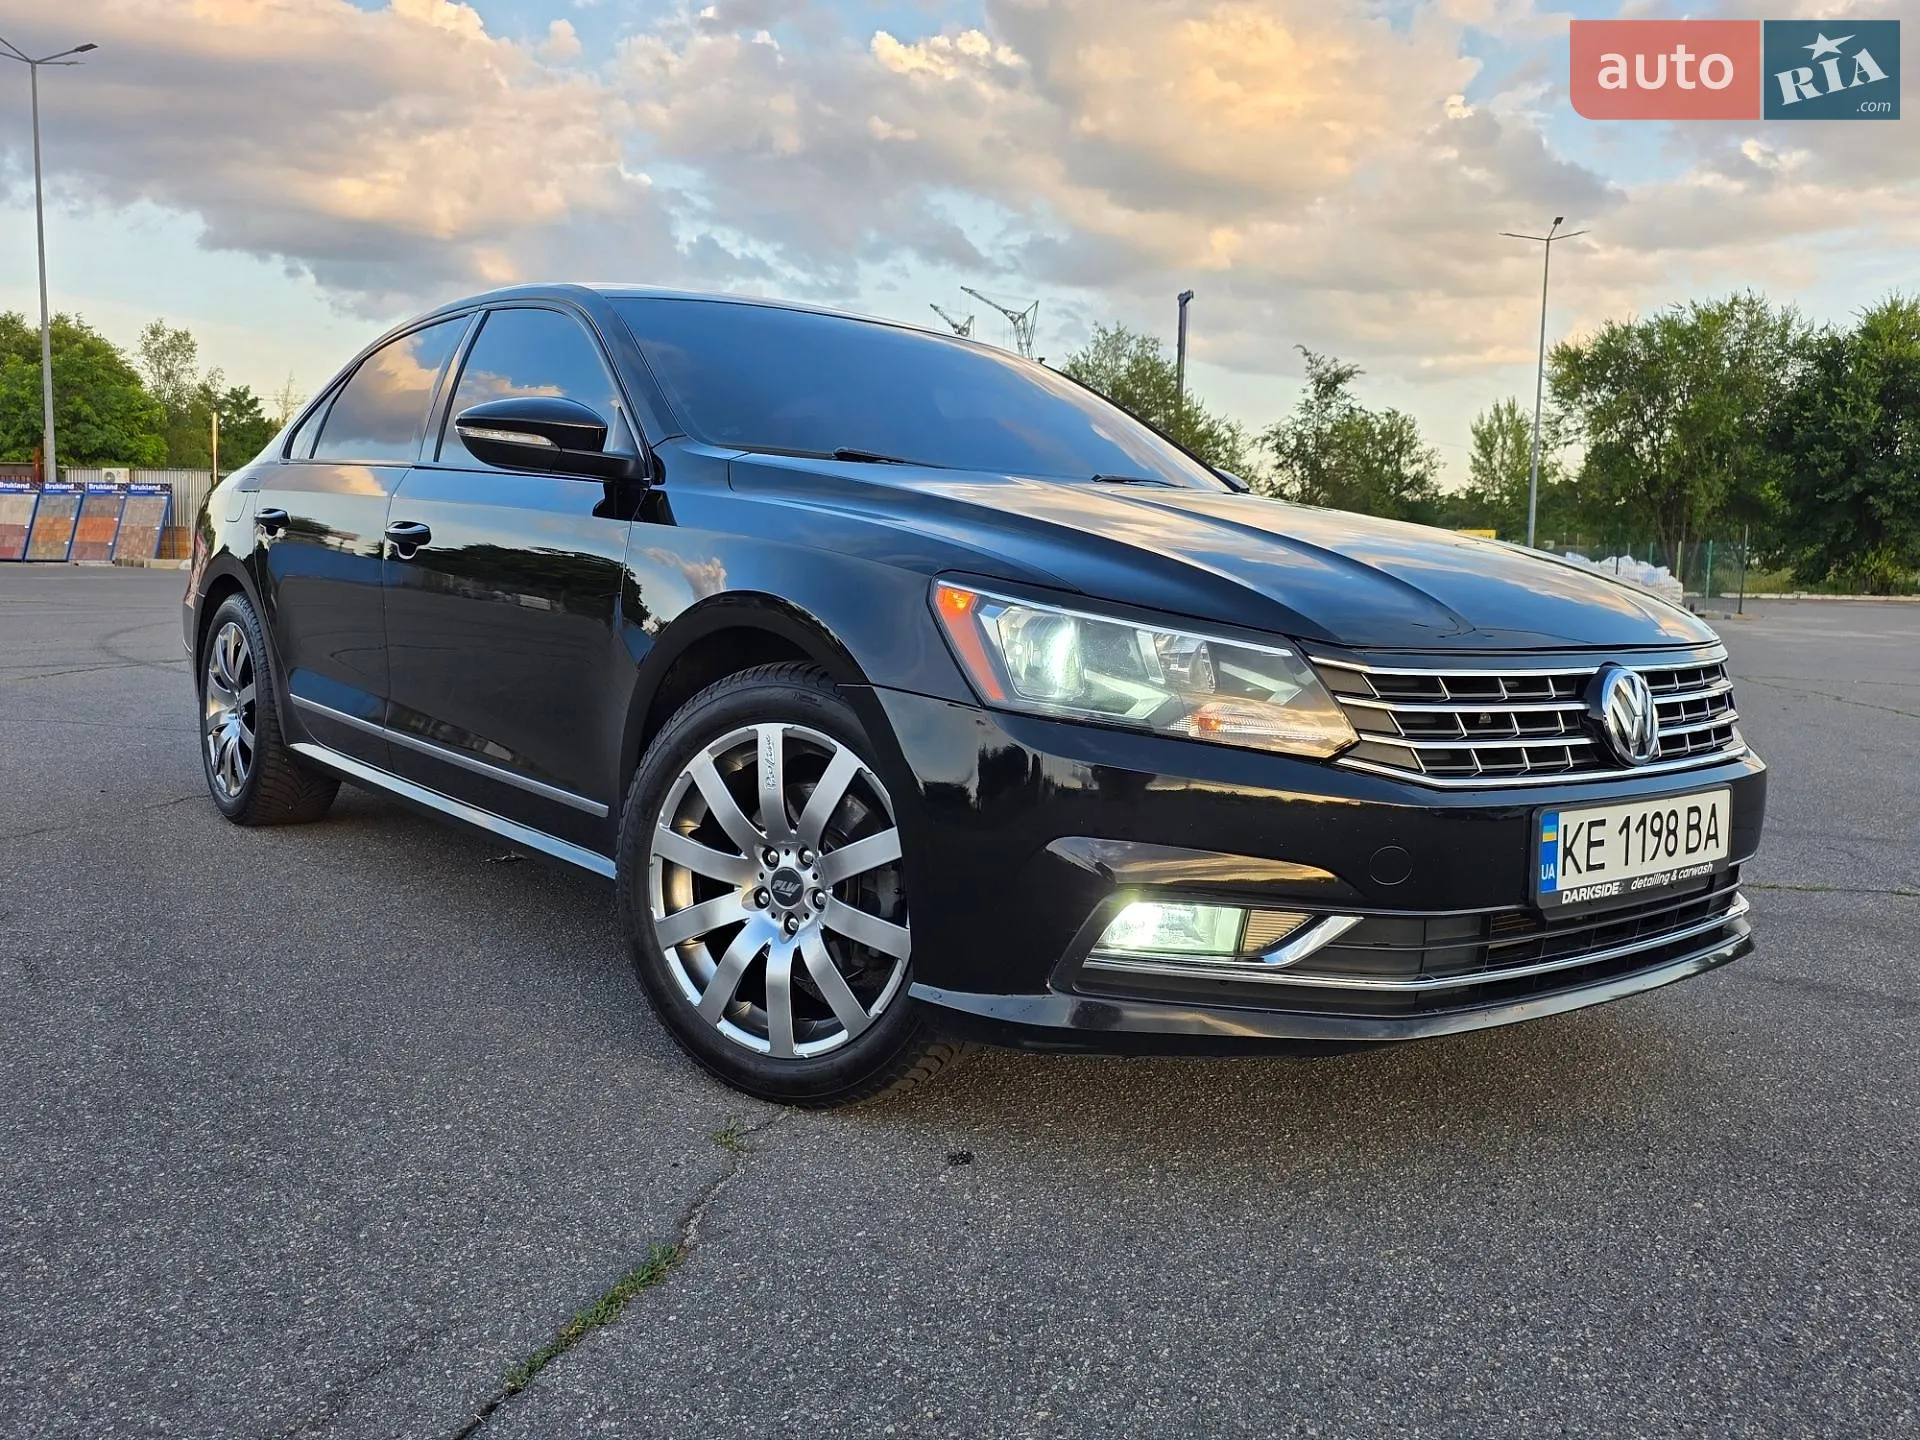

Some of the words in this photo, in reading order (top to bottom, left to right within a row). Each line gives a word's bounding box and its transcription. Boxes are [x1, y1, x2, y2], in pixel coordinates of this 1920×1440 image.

[1561, 818, 1607, 877] KE
[1618, 809, 1679, 866] 1198
[1685, 802, 1719, 855] BA
[1541, 863, 1555, 880] UA
[1561, 881, 1621, 904] DARKSIDE
[1630, 872, 1670, 891] detailing
[1671, 871, 1677, 882] &
[1678, 861, 1714, 880] carwash
